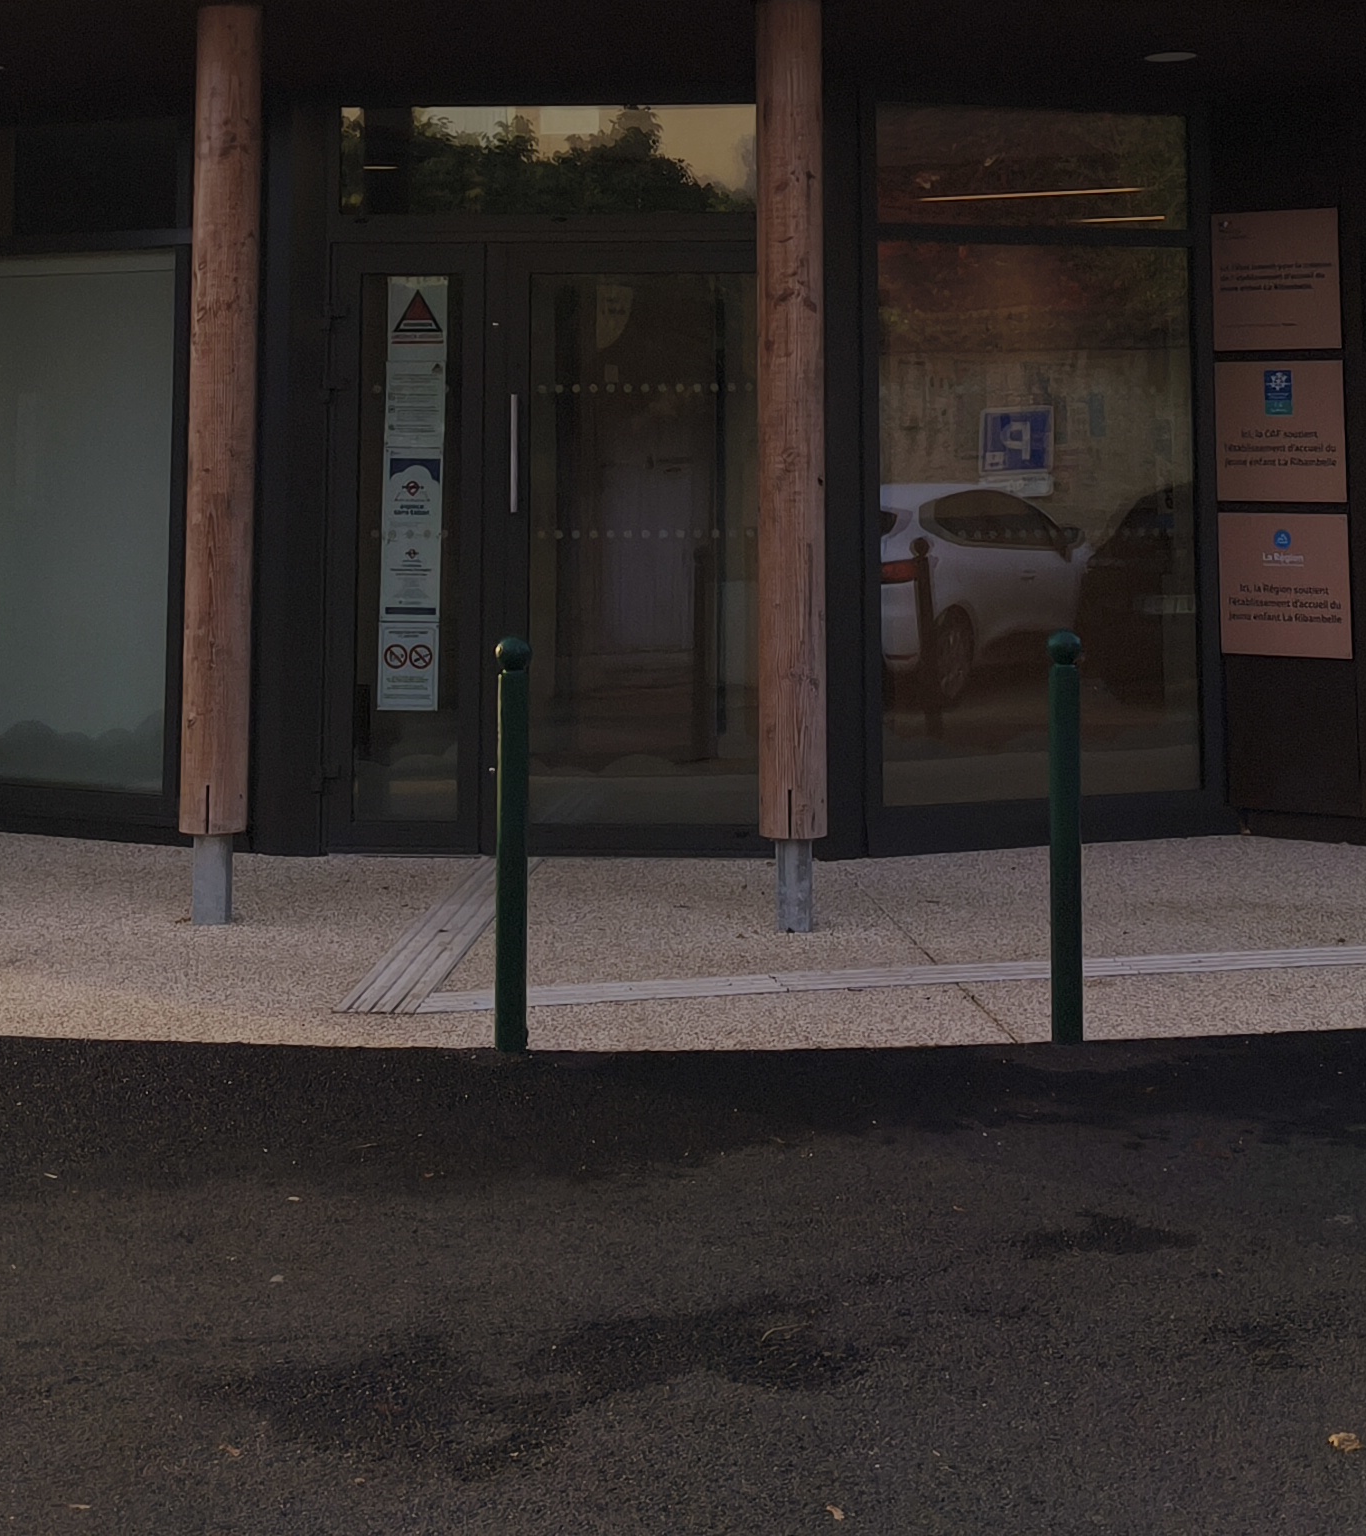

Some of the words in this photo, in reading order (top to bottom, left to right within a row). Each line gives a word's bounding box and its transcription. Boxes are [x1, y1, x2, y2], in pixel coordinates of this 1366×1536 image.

[1262, 552, 1273, 561] La
[1253, 584, 1262, 593] la
[1263, 583, 1292, 595] Région
[1329, 600, 1342, 610] du
